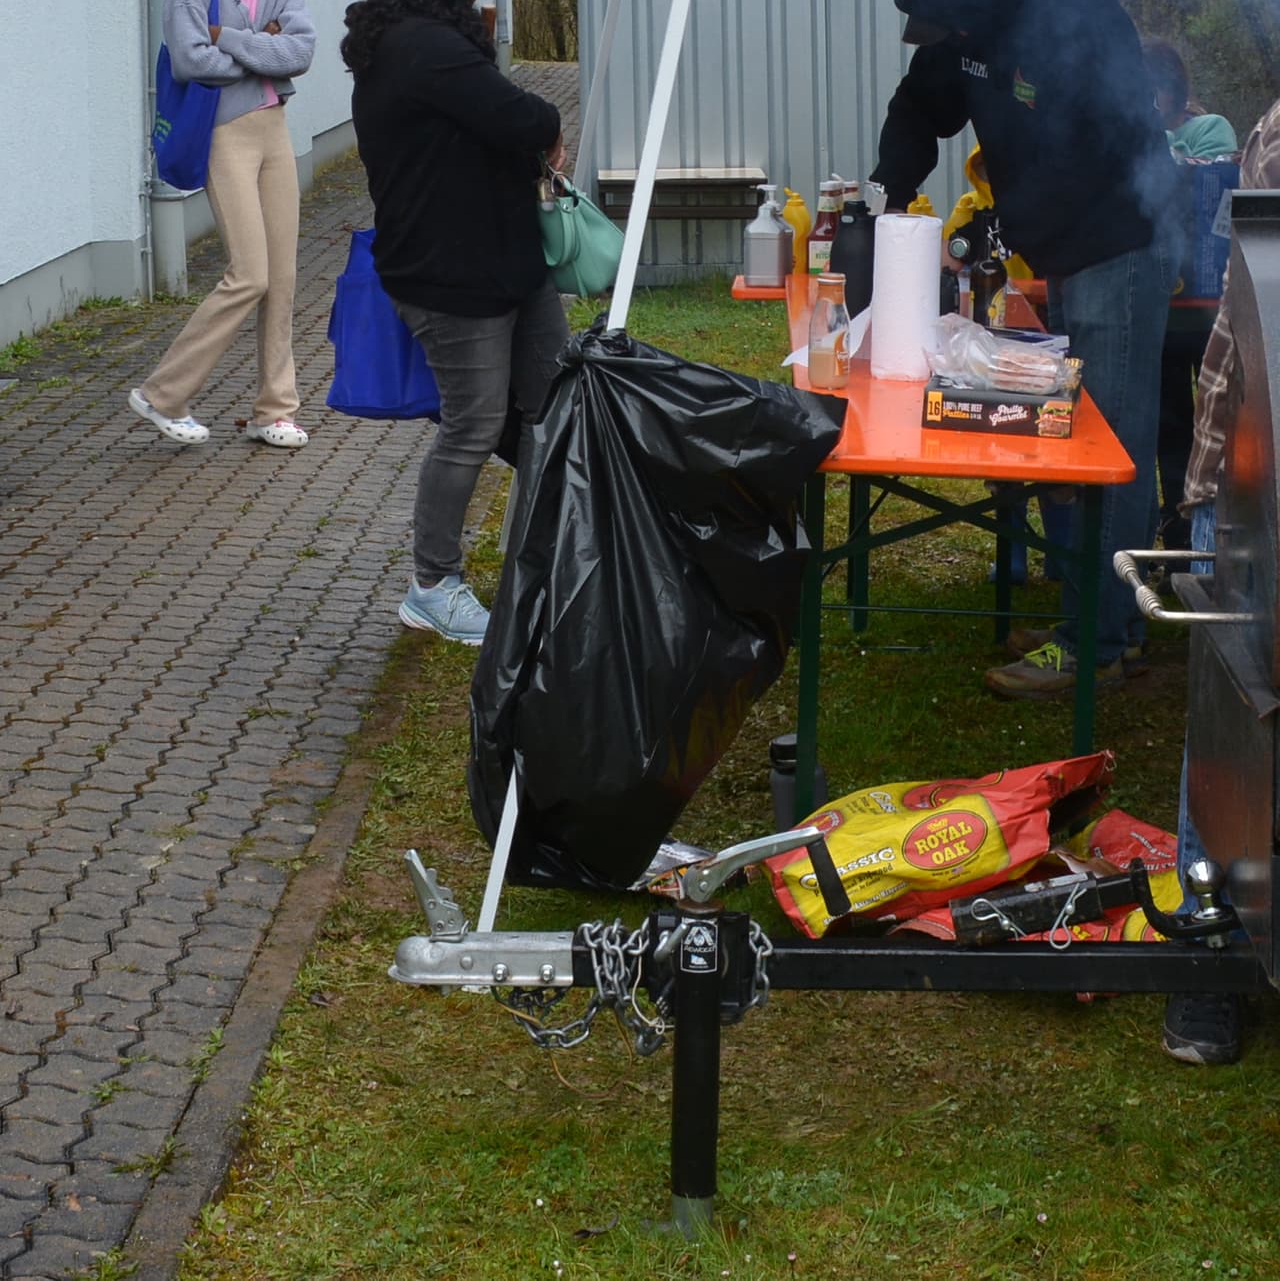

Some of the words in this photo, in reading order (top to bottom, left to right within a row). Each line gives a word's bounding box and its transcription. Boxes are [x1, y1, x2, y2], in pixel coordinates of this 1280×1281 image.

[928, 401, 941, 416] 16
[989, 411, 1028, 427] Gourmet
[914, 820, 973, 857] ROYAL
[931, 840, 971, 866] OAK
[799, 847, 897, 890] CASSIC
